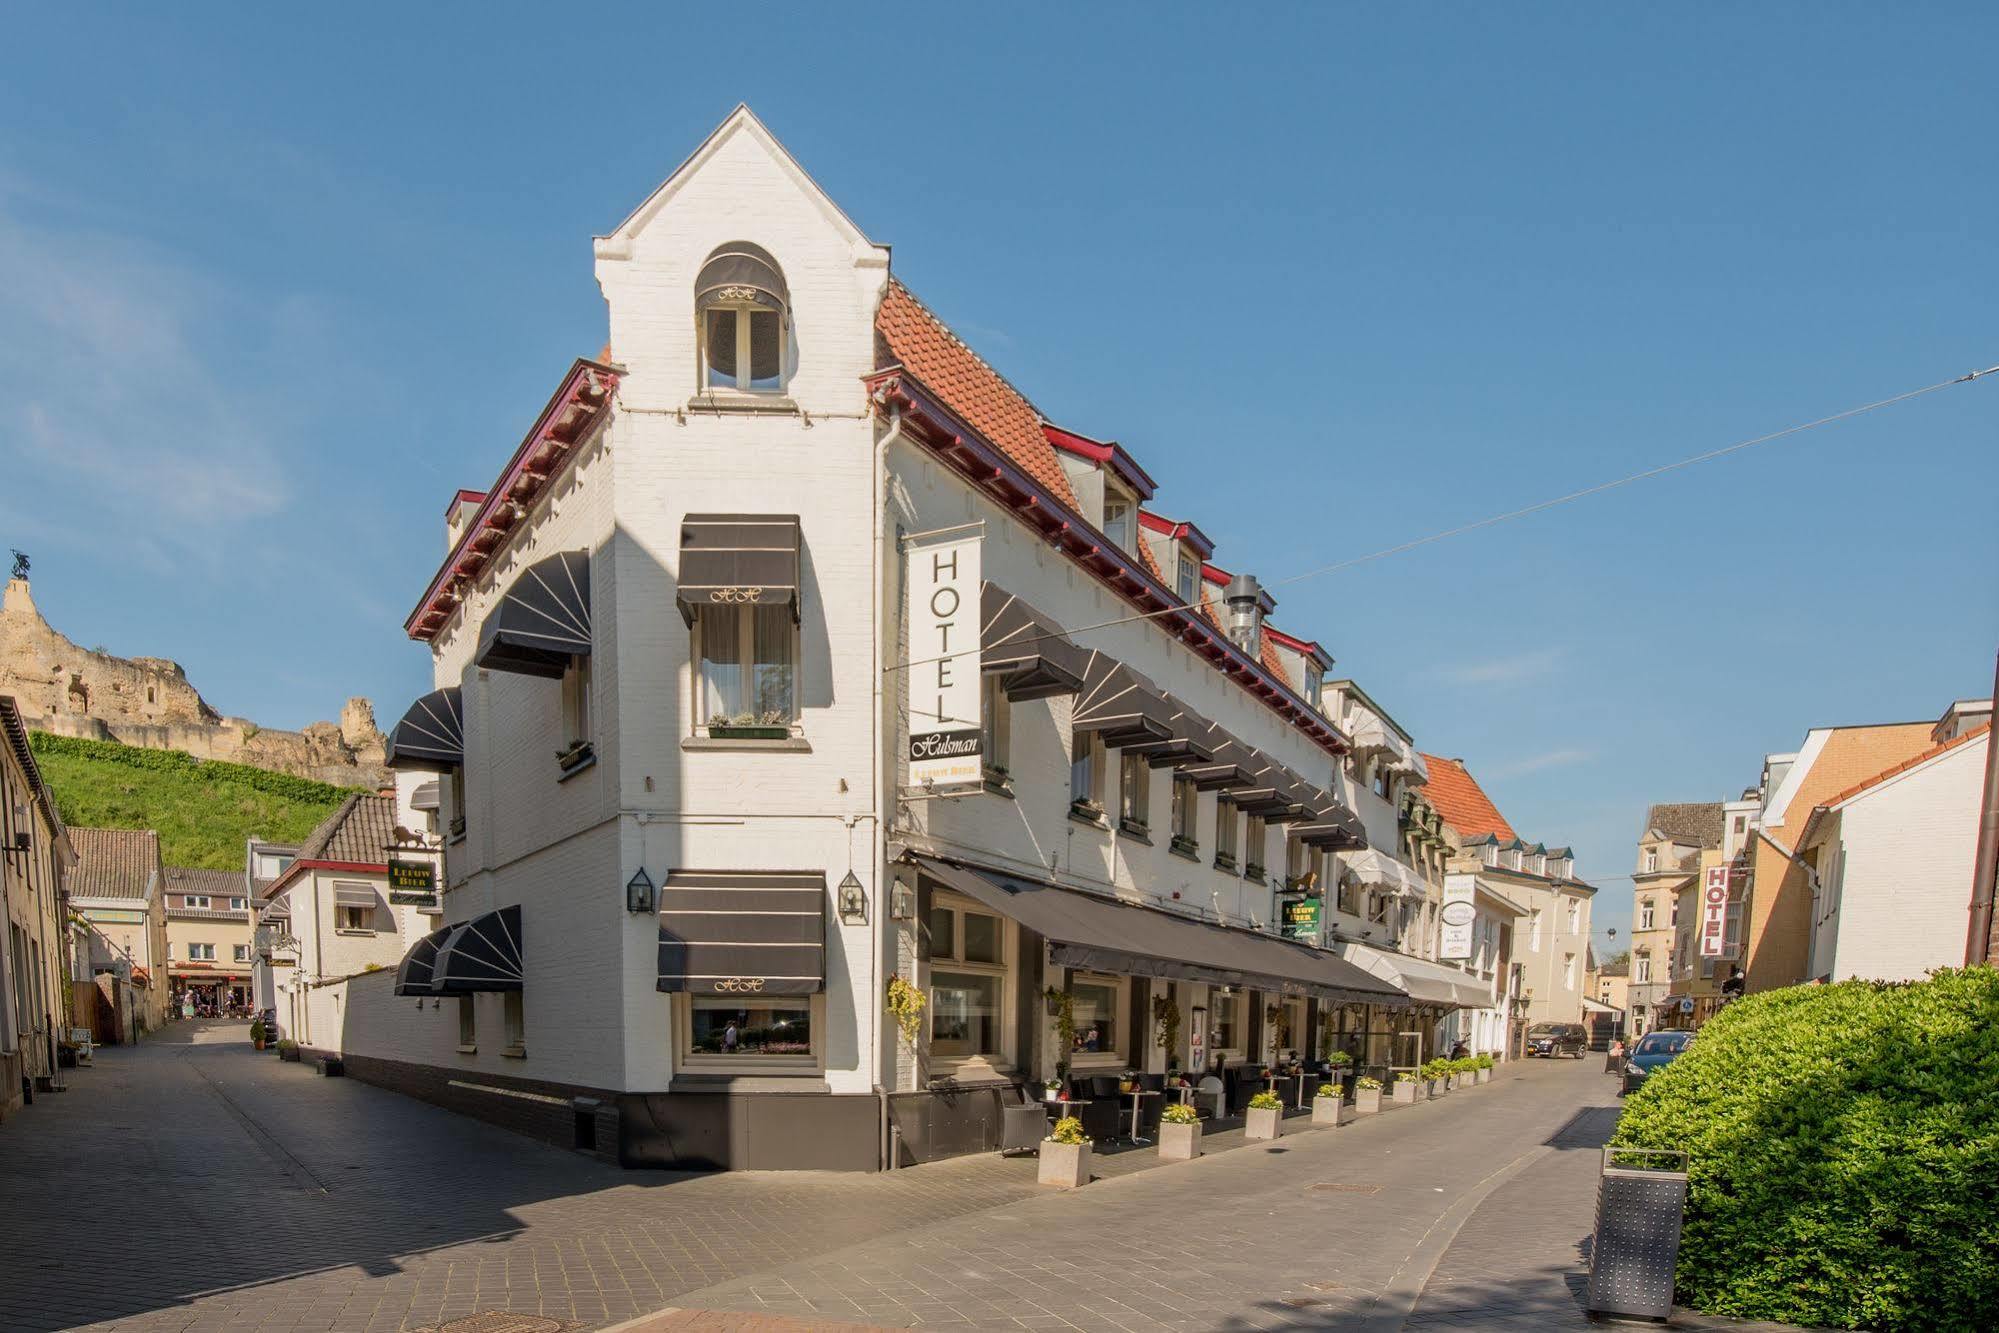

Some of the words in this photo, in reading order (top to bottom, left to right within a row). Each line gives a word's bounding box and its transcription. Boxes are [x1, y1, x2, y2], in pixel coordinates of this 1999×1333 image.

[930, 550, 960, 723] HOTEL
[911, 733, 978, 757] Hulsman
[394, 867, 431, 877] LEEUW
[400, 877, 425, 887] BIER
[1704, 869, 1725, 953] HOTEL
